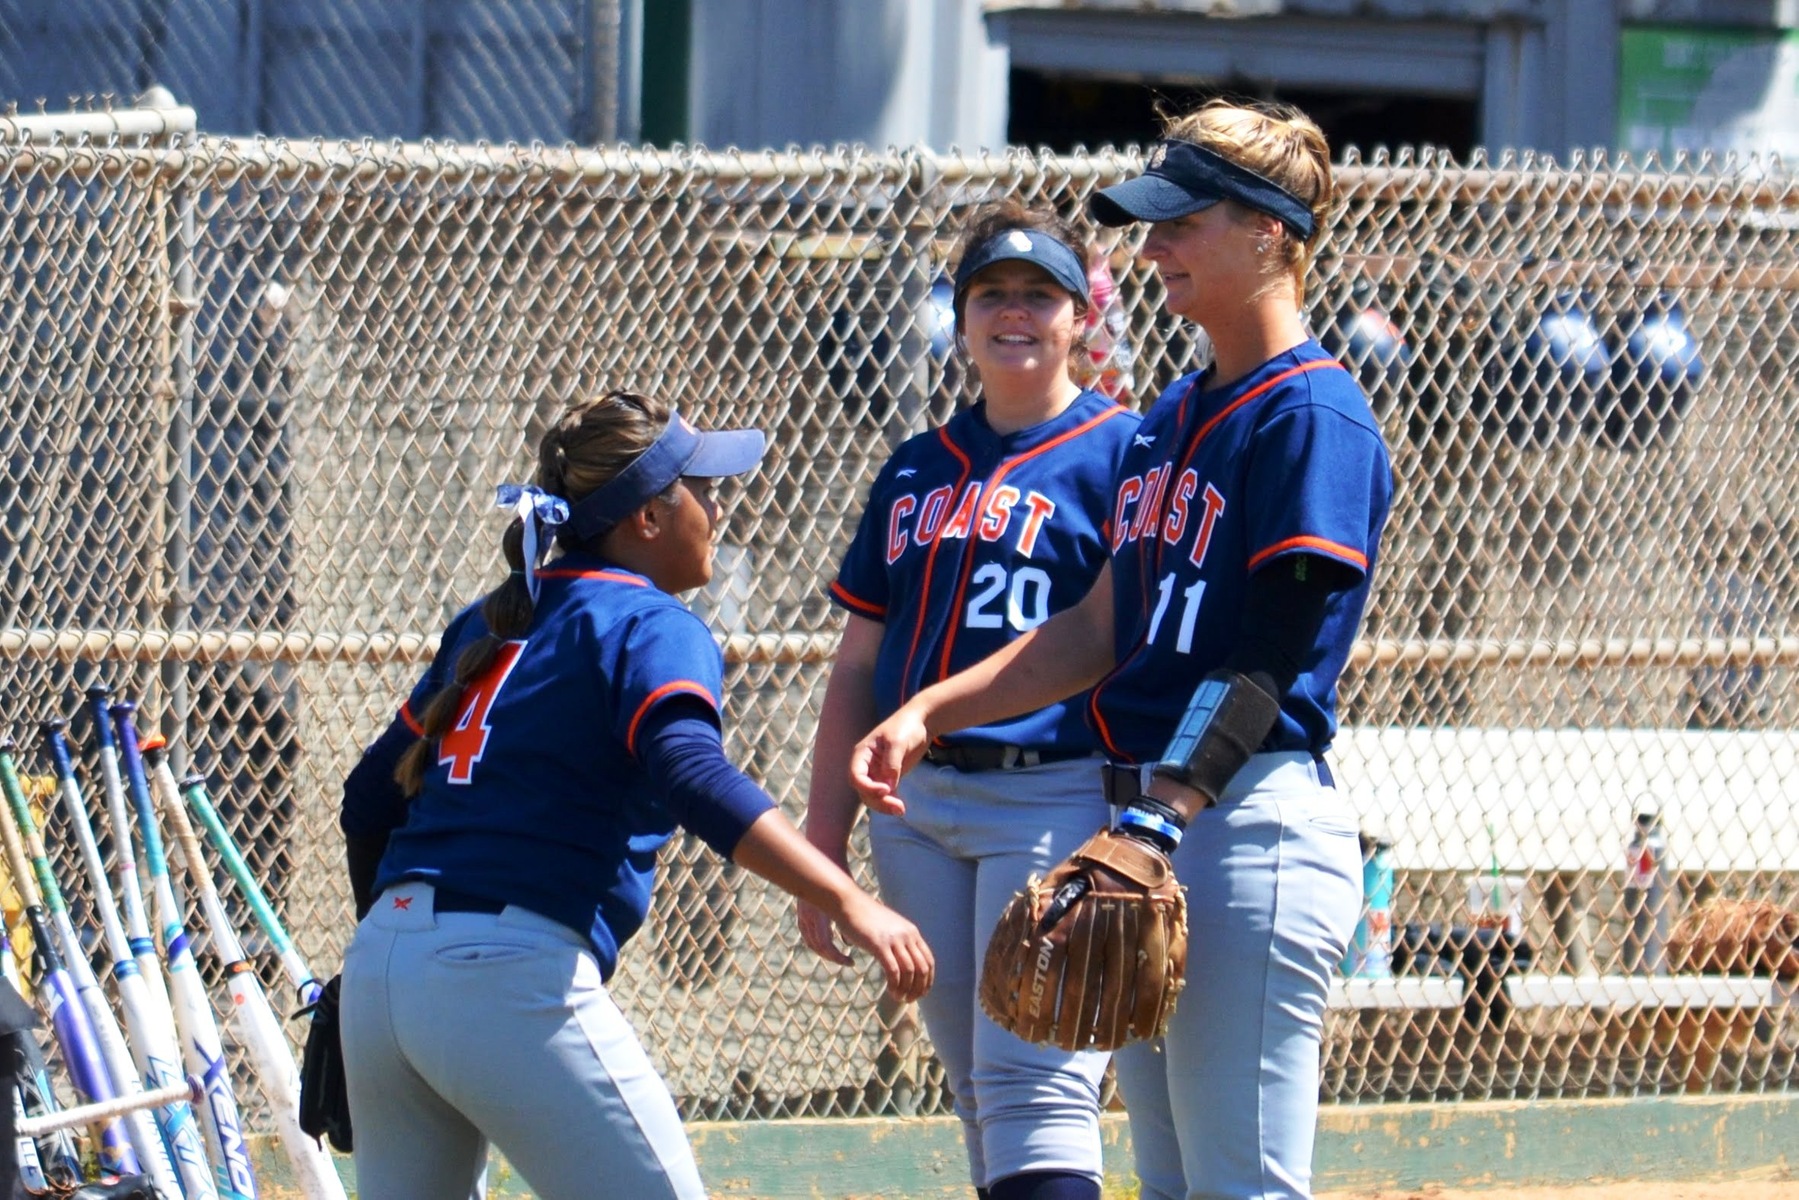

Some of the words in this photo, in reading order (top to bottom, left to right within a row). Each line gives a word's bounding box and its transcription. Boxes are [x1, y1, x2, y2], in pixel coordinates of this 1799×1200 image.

[887, 481, 1056, 566] COAST
[1112, 461, 1226, 569] COAST
[965, 563, 1052, 632] 20
[1147, 572, 1207, 654] 11
[438, 640, 528, 785] 4
[1029, 937, 1055, 1018] EASTON
[193, 1037, 257, 1199] XENO
